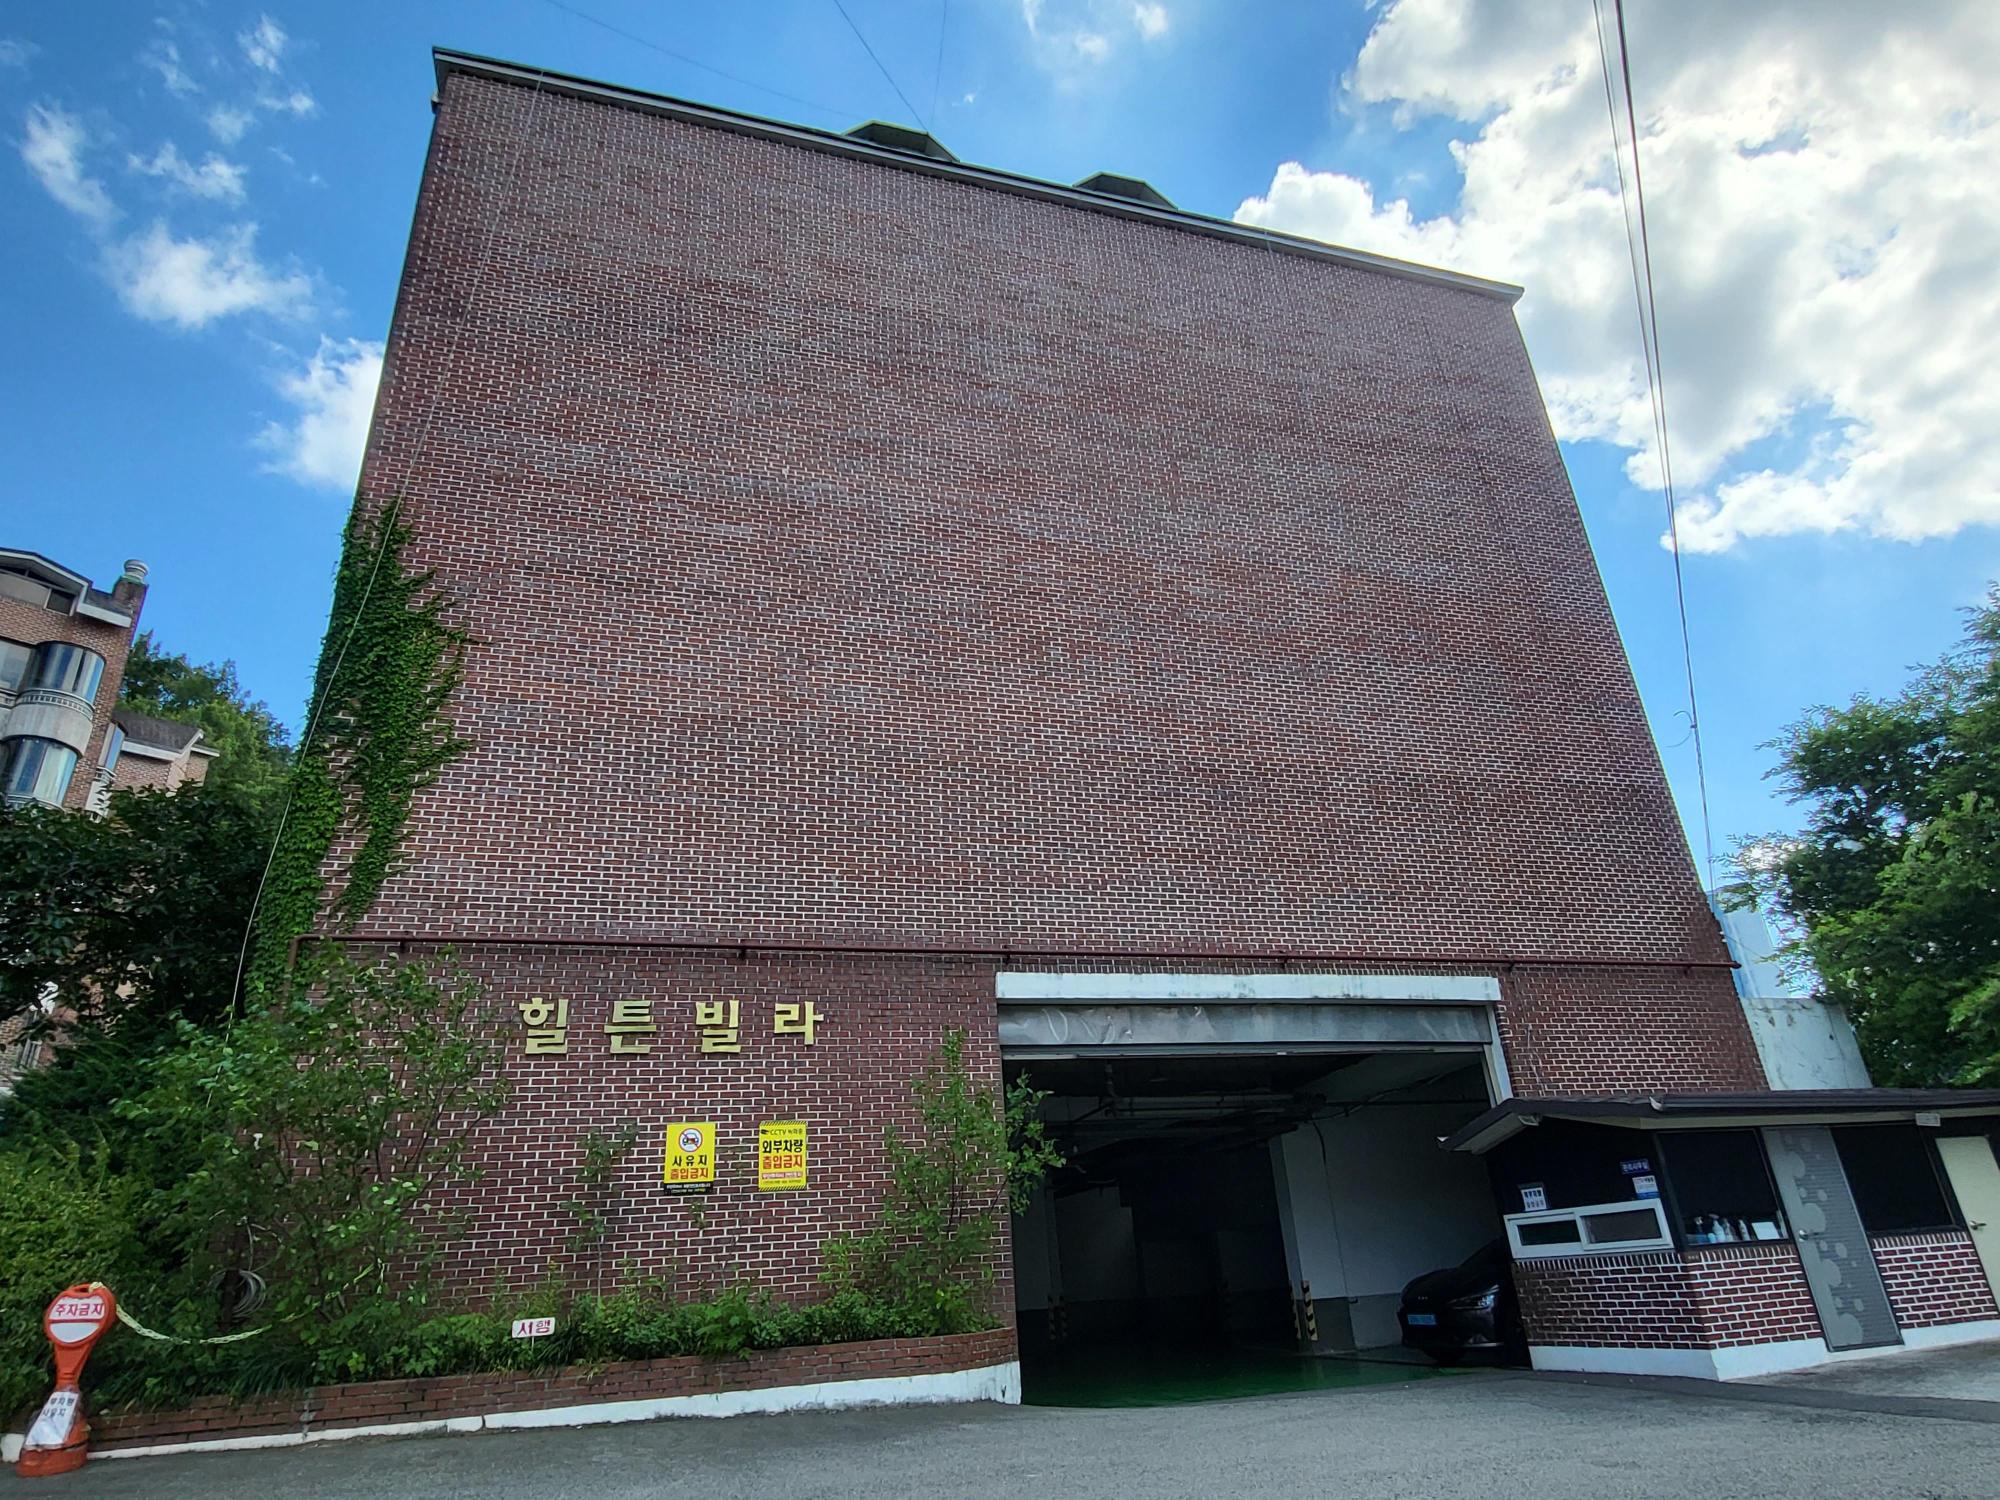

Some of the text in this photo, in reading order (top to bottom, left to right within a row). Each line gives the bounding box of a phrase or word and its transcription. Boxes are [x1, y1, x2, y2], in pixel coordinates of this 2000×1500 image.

[519, 998, 824, 1053] 힐튼빌라
[762, 1139, 803, 1153] 외부차량
[672, 1154, 708, 1166] 사유지
[762, 1155, 803, 1169] 출입금지
[670, 1168, 709, 1180] 출입금지
[517, 1320, 551, 1335] 서행
